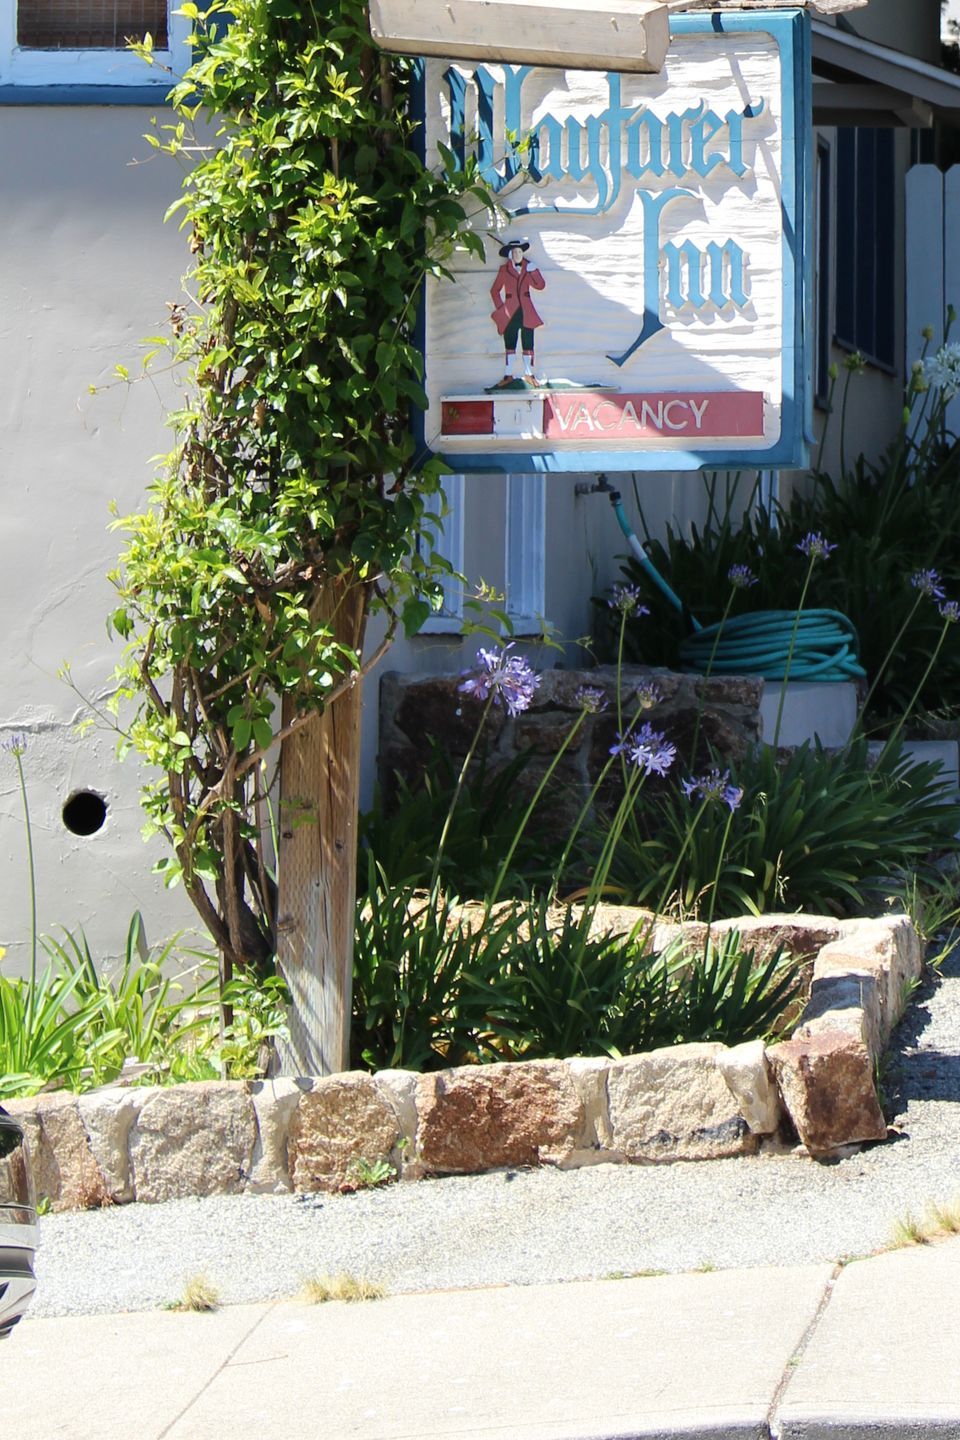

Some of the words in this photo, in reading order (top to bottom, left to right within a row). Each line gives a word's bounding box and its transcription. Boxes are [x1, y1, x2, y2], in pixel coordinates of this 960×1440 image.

[442, 64, 765, 216] Wayfarer
[606, 187, 752, 367] Inn
[550, 398, 709, 431] VACANCY
